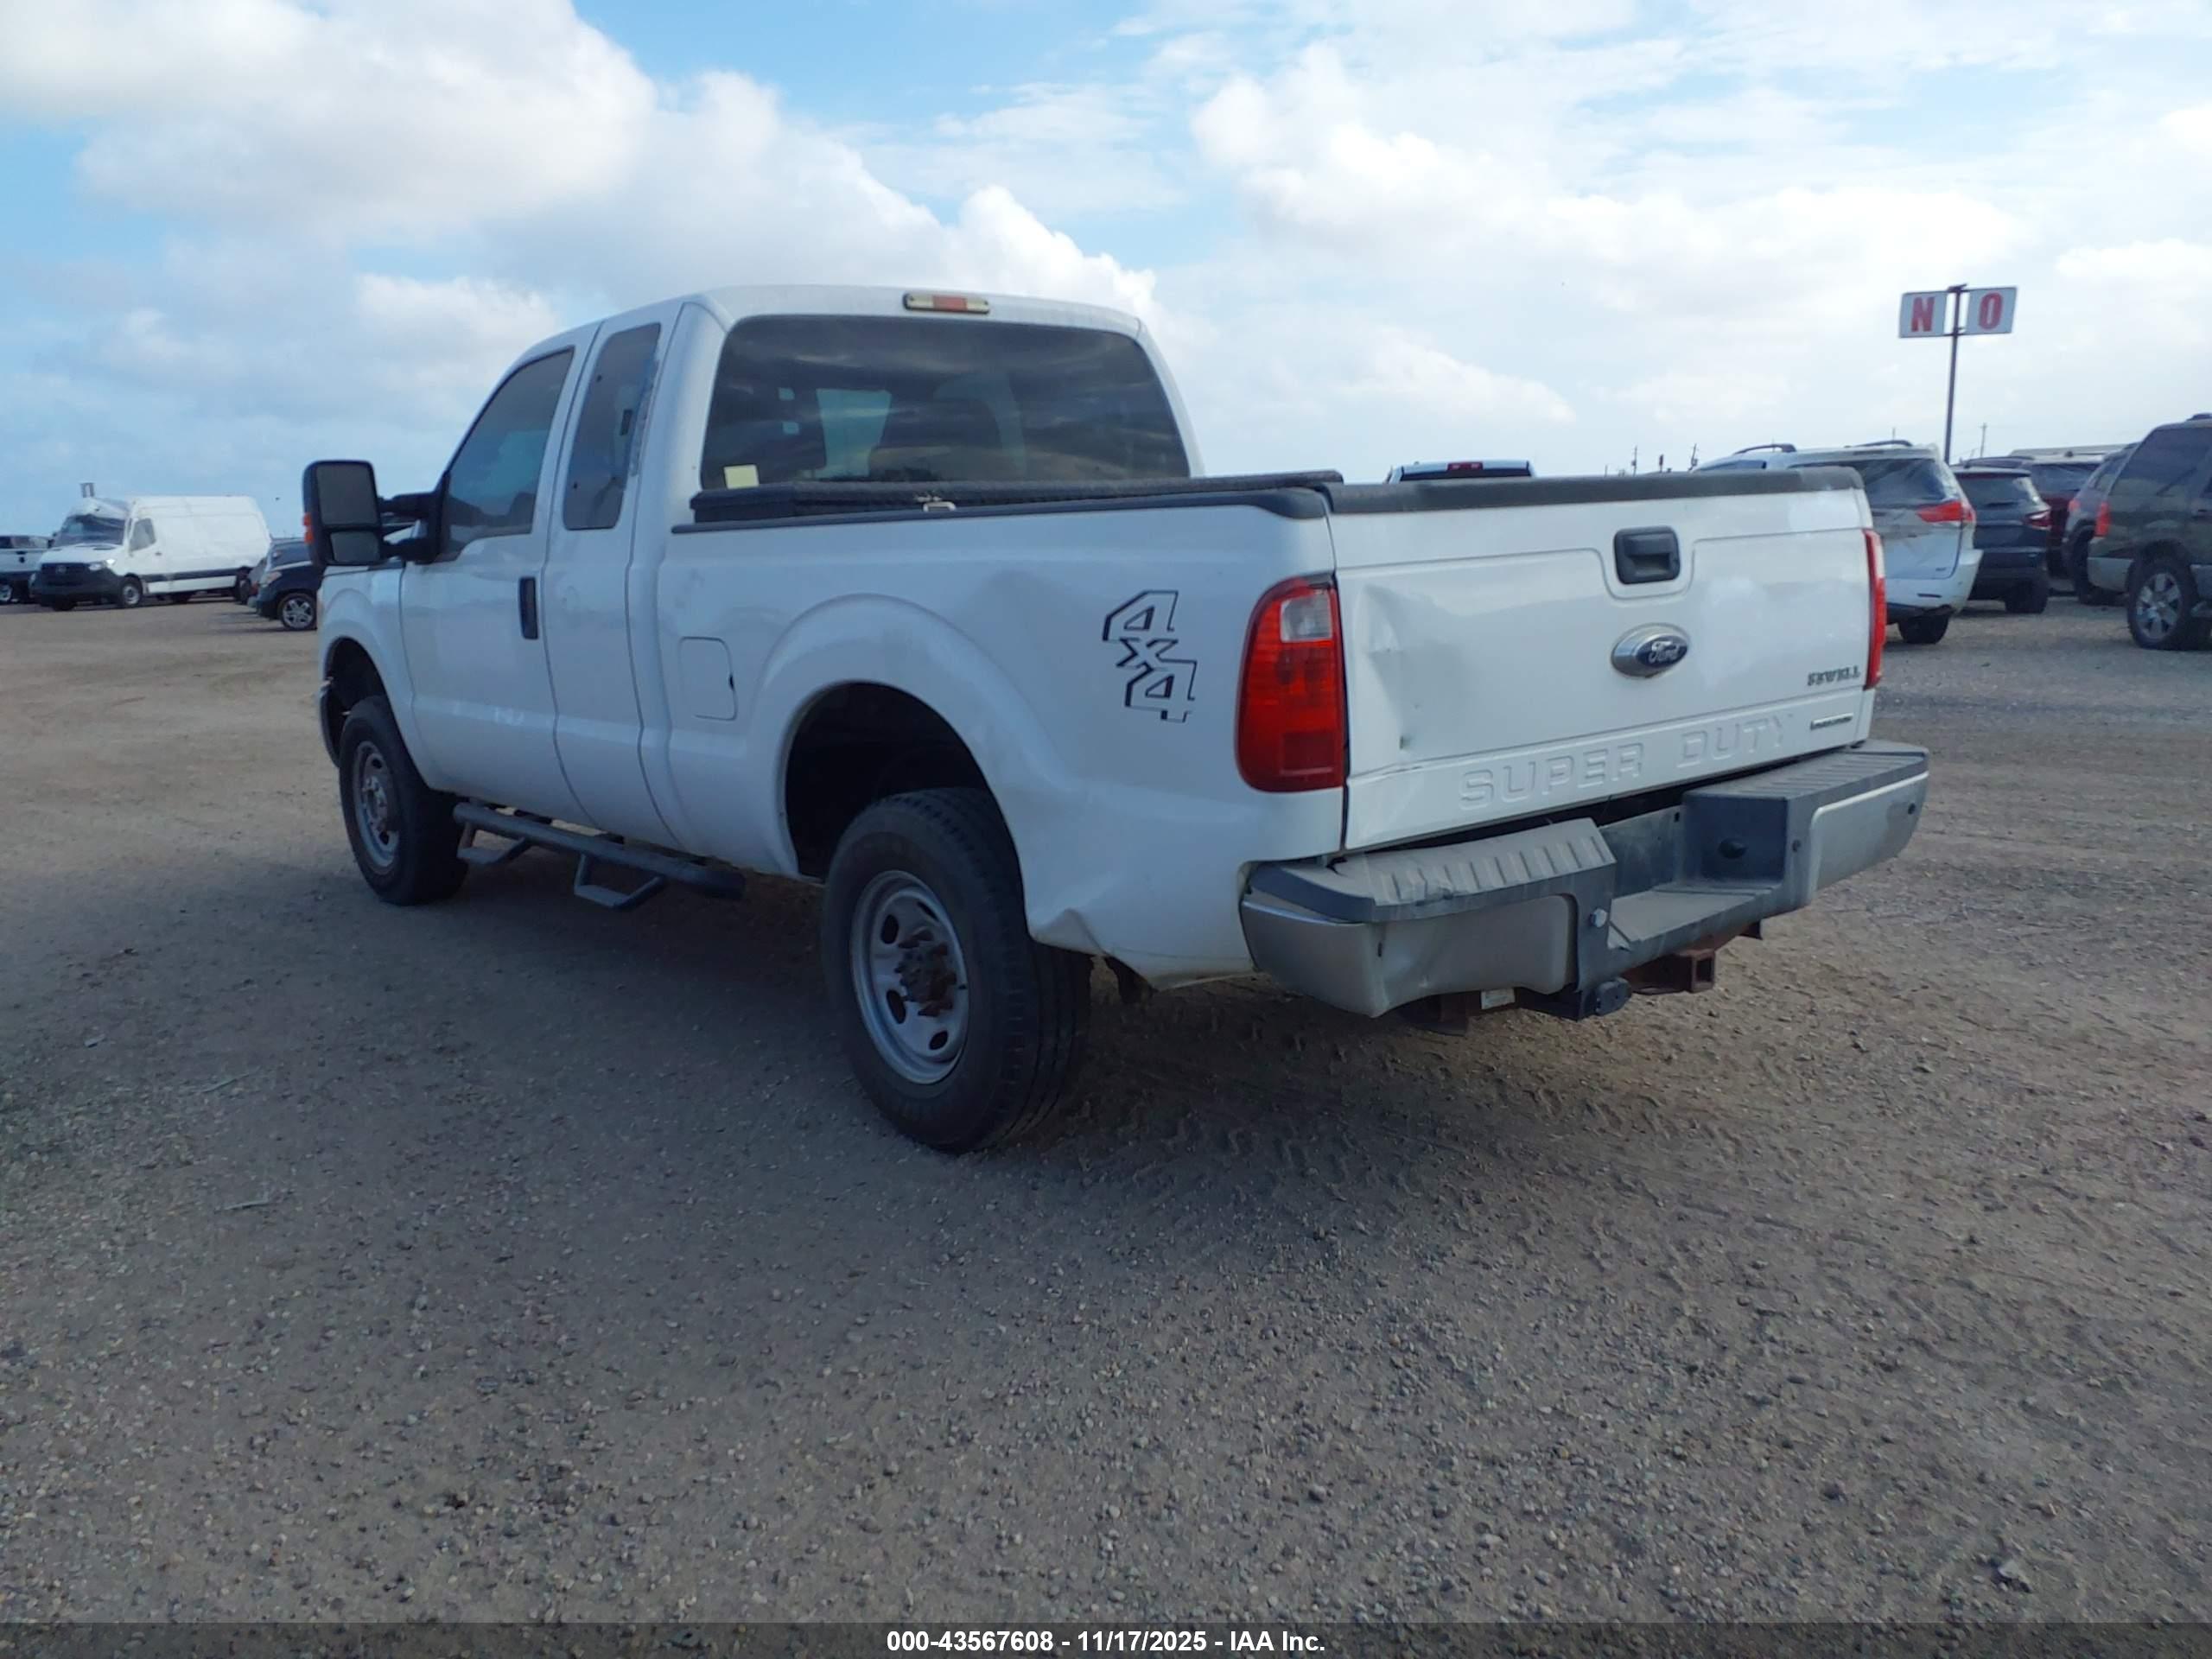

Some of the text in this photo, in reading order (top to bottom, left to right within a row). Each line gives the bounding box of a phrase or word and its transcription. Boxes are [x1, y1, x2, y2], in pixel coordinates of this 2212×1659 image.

[1910, 292, 2003, 332] N O
[1458, 712, 1795, 811] SUPER DUTY
